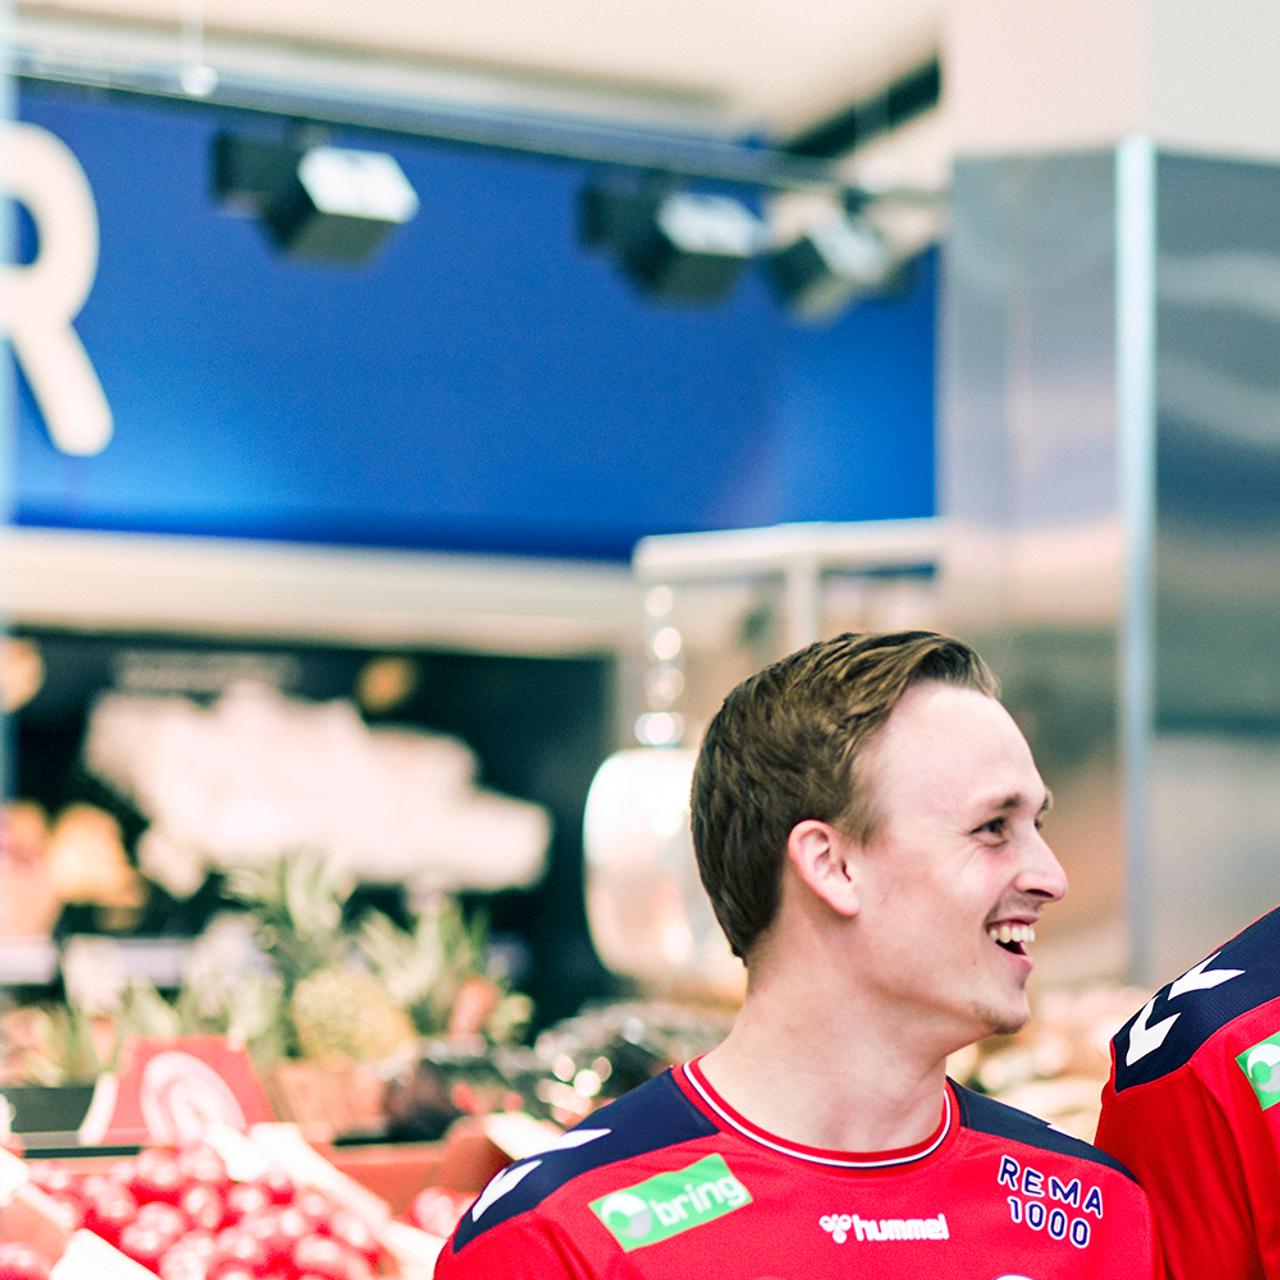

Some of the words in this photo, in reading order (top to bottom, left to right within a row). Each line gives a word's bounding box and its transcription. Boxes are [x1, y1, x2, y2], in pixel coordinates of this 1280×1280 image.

[650, 1172, 750, 1229] bring
[998, 1155, 1104, 1220] REMA
[853, 1212, 949, 1241] hummel
[1007, 1196, 1091, 1249] 1000
